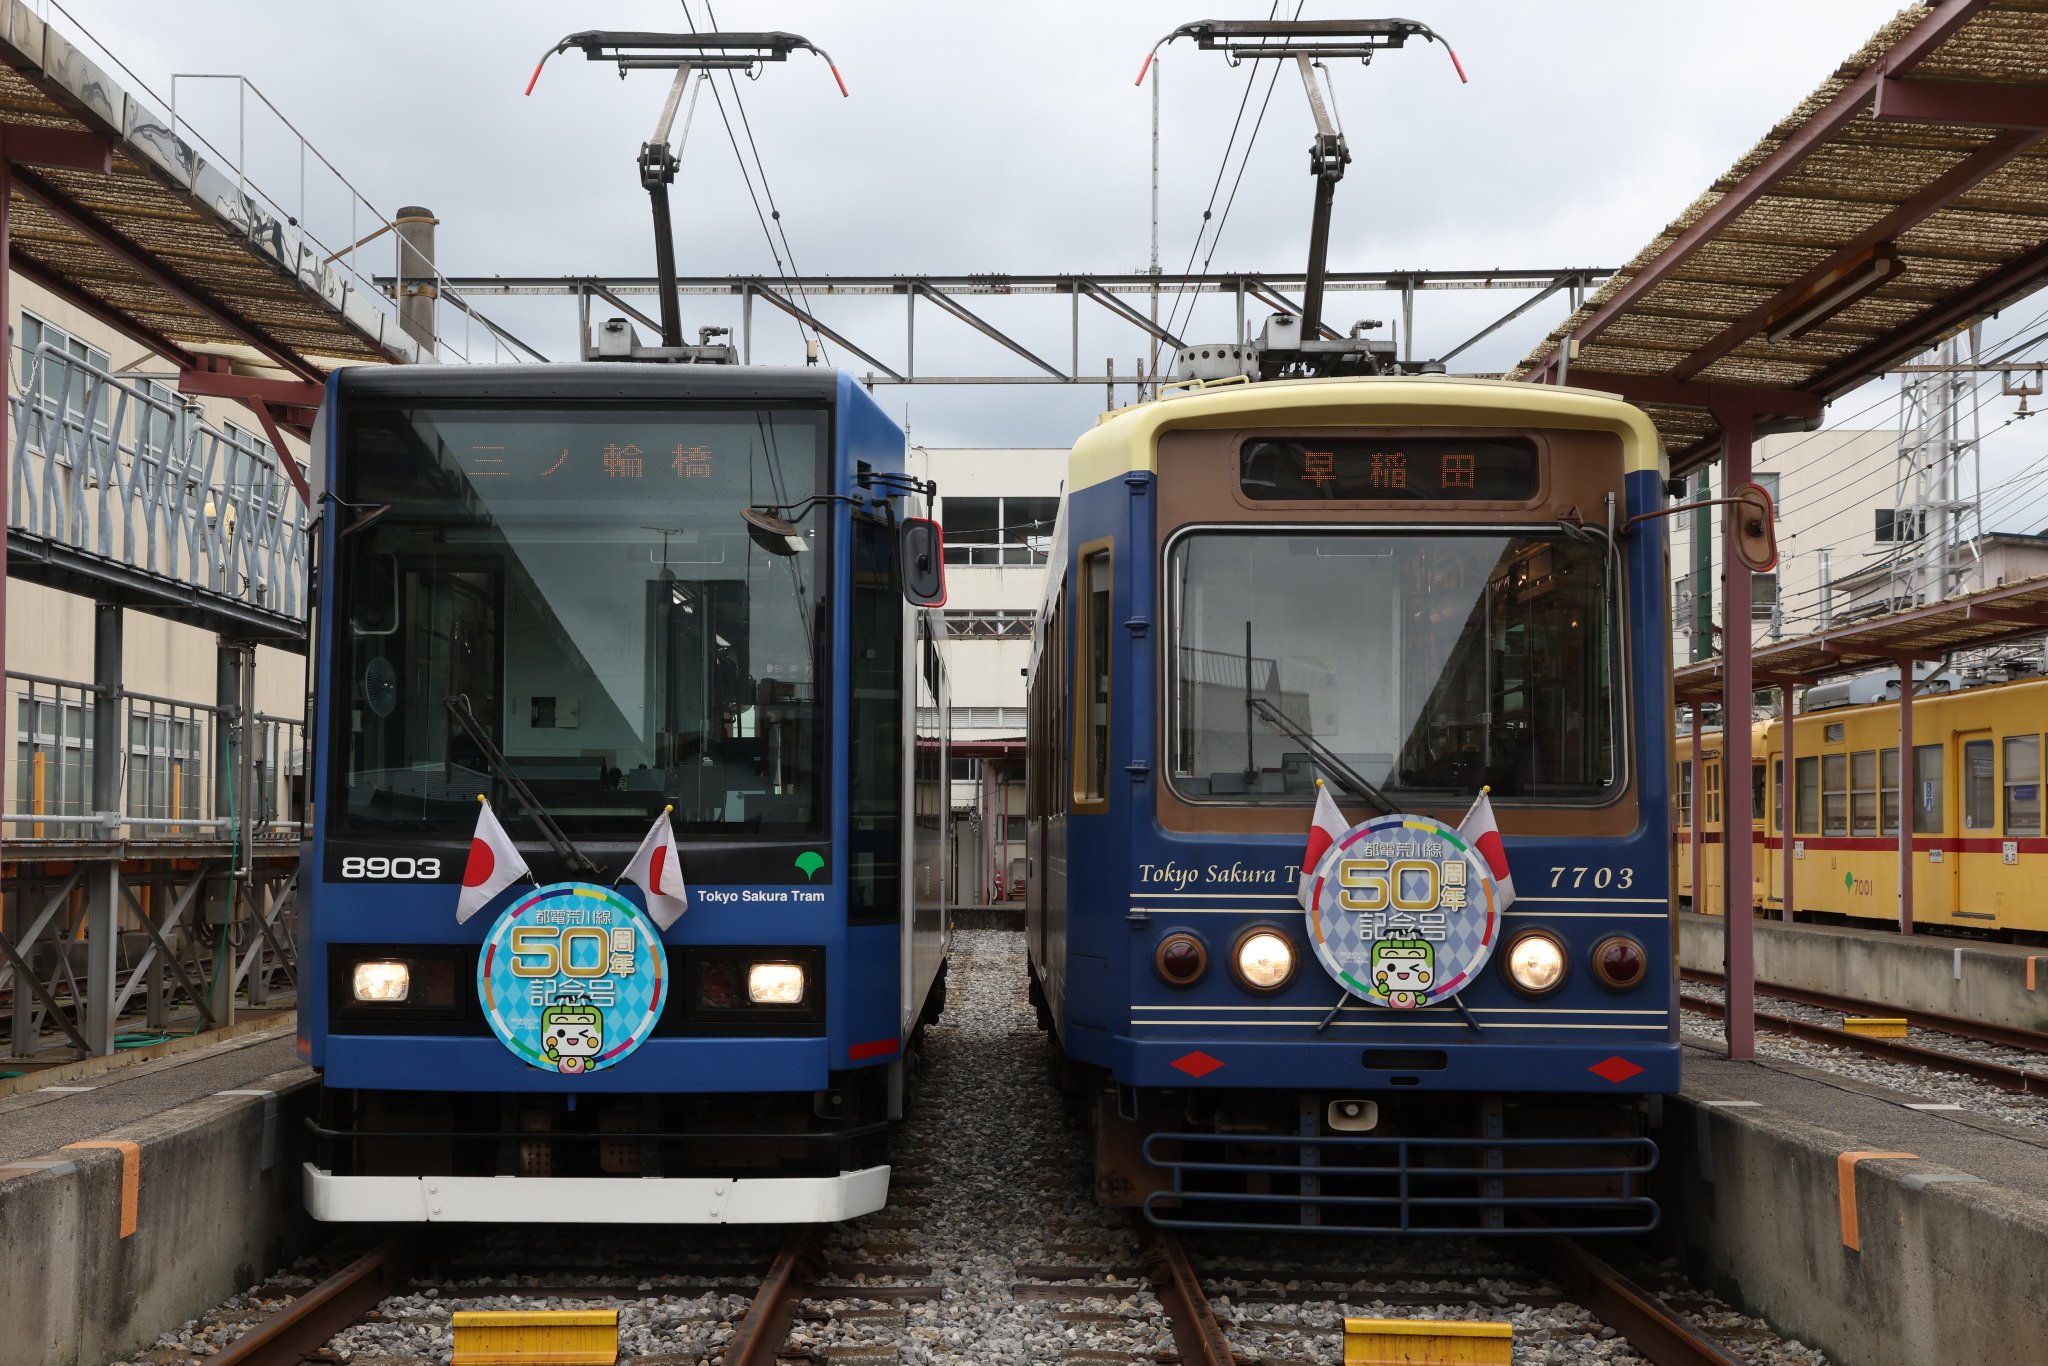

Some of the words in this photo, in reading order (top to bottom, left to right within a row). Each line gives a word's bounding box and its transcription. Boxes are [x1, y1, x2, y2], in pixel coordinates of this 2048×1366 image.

[469, 443, 712, 478] 三ノ輪橋
[1301, 452, 1475, 488] 早稲田
[1364, 842, 1443, 858] 都電荒川線
[342, 857, 441, 879] 8903
[1139, 860, 1199, 891] Tokyo
[1205, 861, 1276, 883] Sakura
[1550, 867, 1634, 889] 7703
[697, 890, 738, 904] Tokyo
[742, 890, 788, 902] Sakura
[791, 890, 825, 902] Tram
[1853, 879, 1873, 896] 7001
[535, 910, 612, 925] 都電荒川線
[1359, 912, 1447, 941] 記念号
[530, 978, 615, 1007] 記念号
